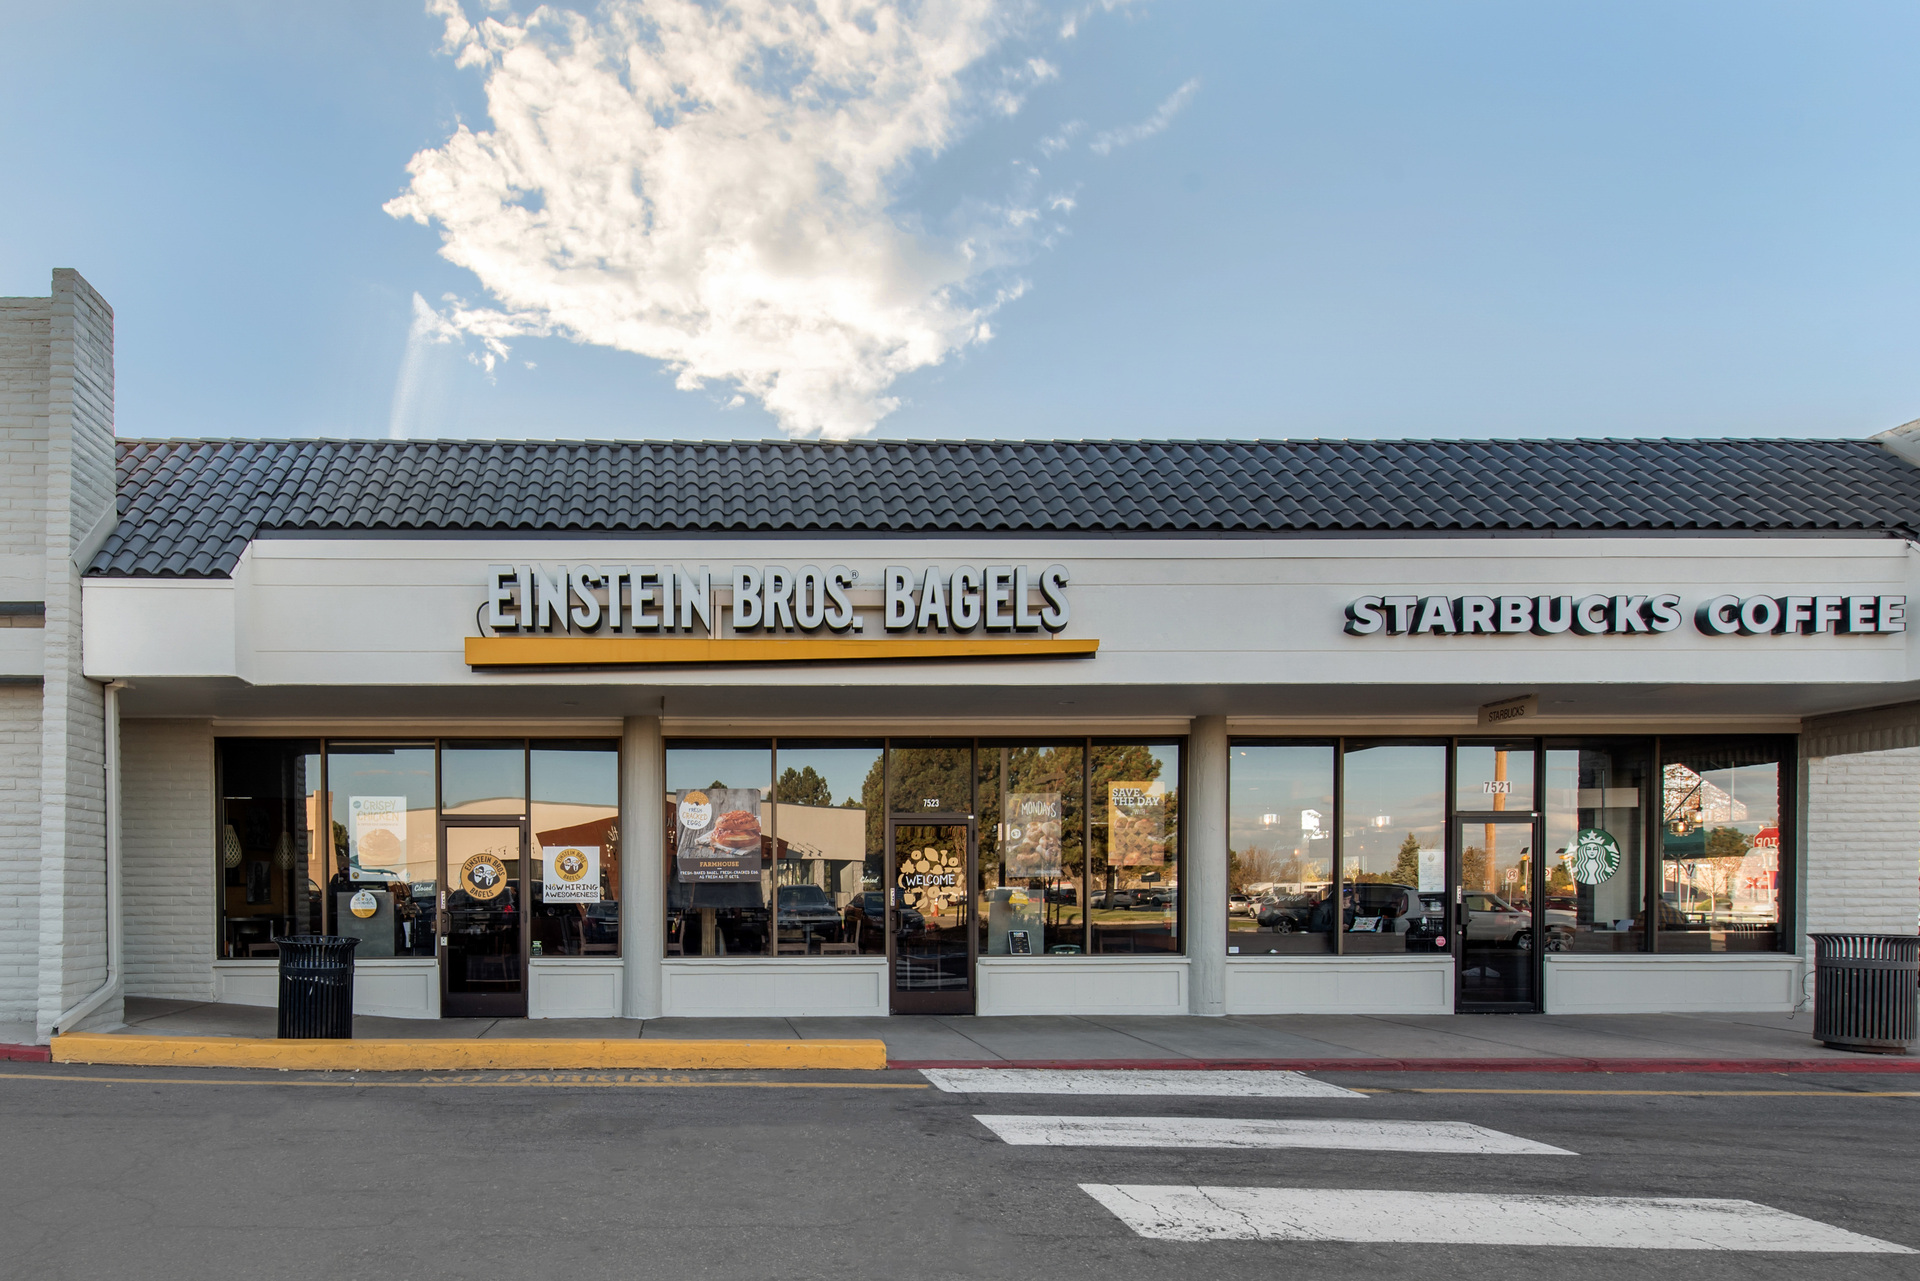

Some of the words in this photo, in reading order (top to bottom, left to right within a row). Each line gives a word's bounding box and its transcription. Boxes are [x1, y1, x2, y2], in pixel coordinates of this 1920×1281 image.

[488, 563, 711, 634] EINSTEIN
[884, 564, 1070, 634] BAGELS
[1344, 594, 1682, 636] STARBUCKS
[1694, 594, 1906, 637] COFFEE
[1488, 705, 1525, 723] STARBUCKS
[1112, 787, 1140, 797] SAVE
[1485, 781, 1511, 793] 7521
[363, 799, 397, 811] CRISPY
[923, 799, 940, 808] 7523
[1112, 796, 1135, 806] THE
[1137, 796, 1160, 806] DAY
[1021, 800, 1057, 818] MONDAYS
[357, 810, 400, 822] CHICKEN
[682, 811, 709, 821] CRACKED
[686, 819, 702, 827] EGGS
[464, 855, 493, 872] EINSTEIN
[492, 860, 506, 877] BROS
[860, 876, 879, 884] Closed
[905, 874, 956, 886] WELCOME
[413, 883, 434, 892] Closed
[469, 887, 494, 898] BAGELS
[545, 883, 564, 891] NOW
[564, 883, 598, 891] HIRING
[545, 891, 598, 899] AWESOMENESS
